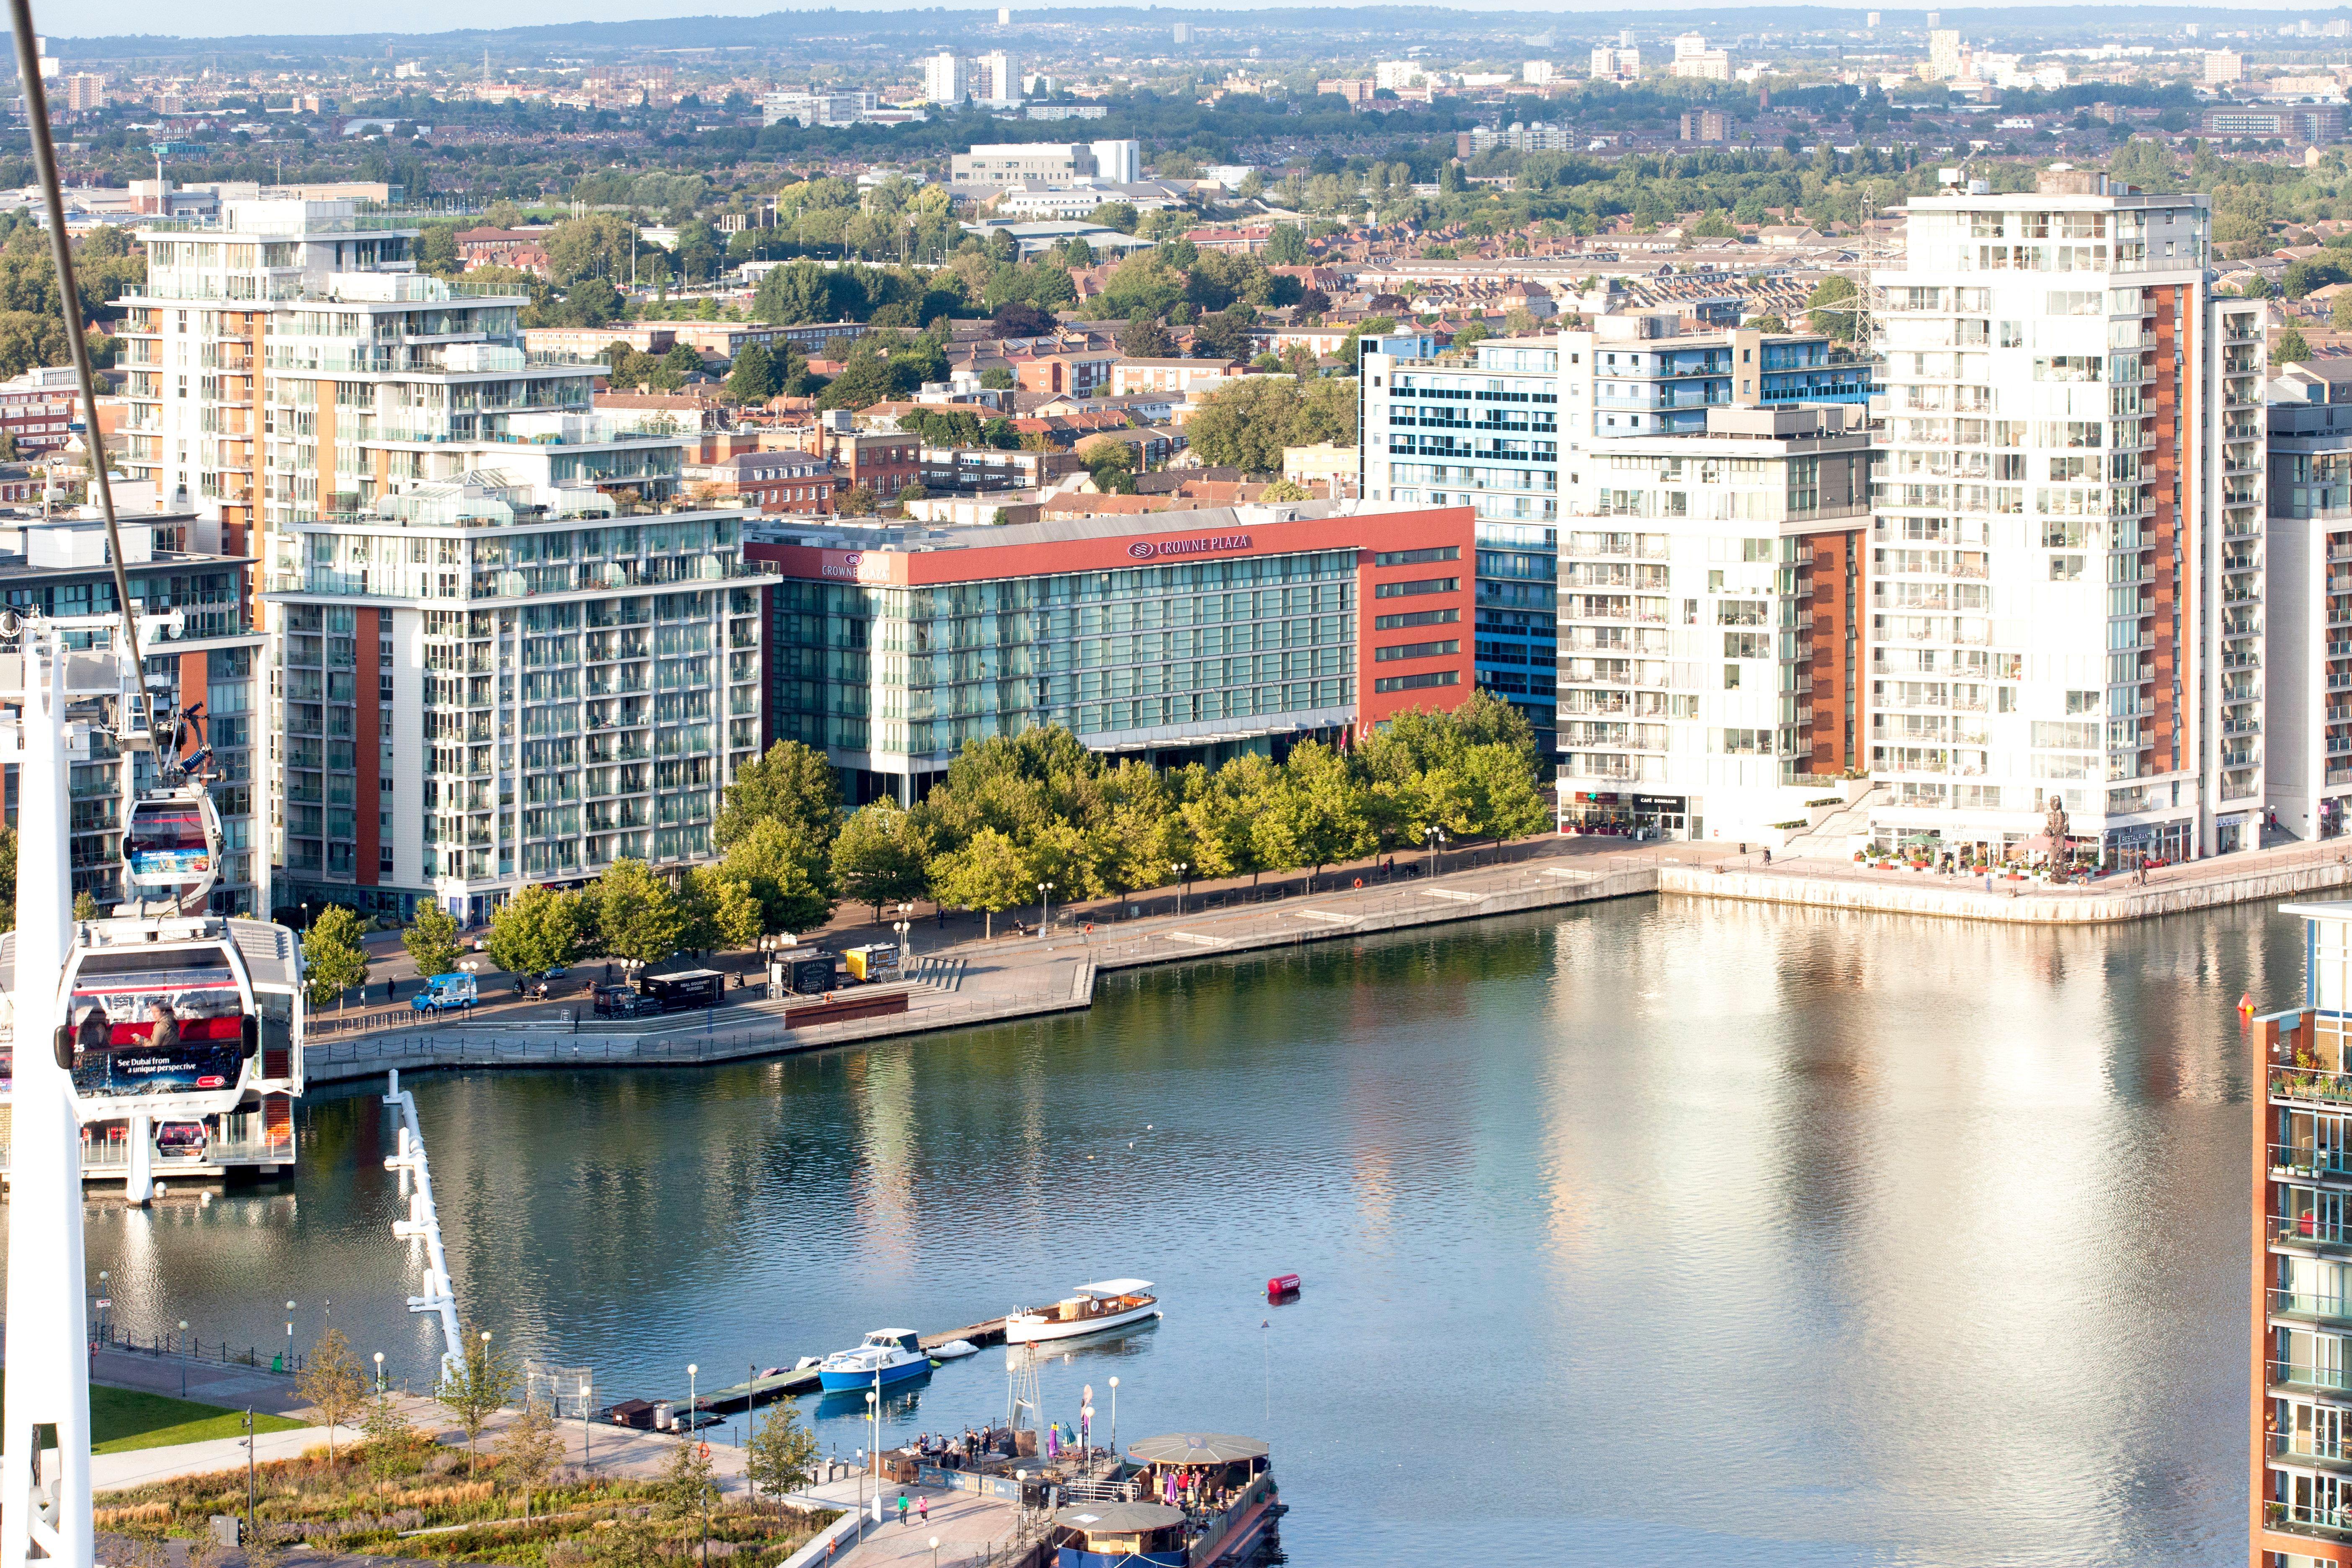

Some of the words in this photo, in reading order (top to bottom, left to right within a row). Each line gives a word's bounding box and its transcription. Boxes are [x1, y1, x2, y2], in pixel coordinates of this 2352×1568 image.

[1158, 539, 1207, 554] CROWNE
[1210, 535, 1247, 549] PLAZA
[822, 565, 858, 578] CROWNE
[861, 568, 888, 580] PLAZA
[2122, 833, 2151, 843] RESTAURANT
[802, 964, 811, 972] FISH
[74, 1044, 85, 1053] 25
[131, 1058, 151, 1066] Dubai
[132, 1065, 156, 1074] unique
[157, 1063, 196, 1073] perspective
[965, 1476, 995, 1495] OILER
